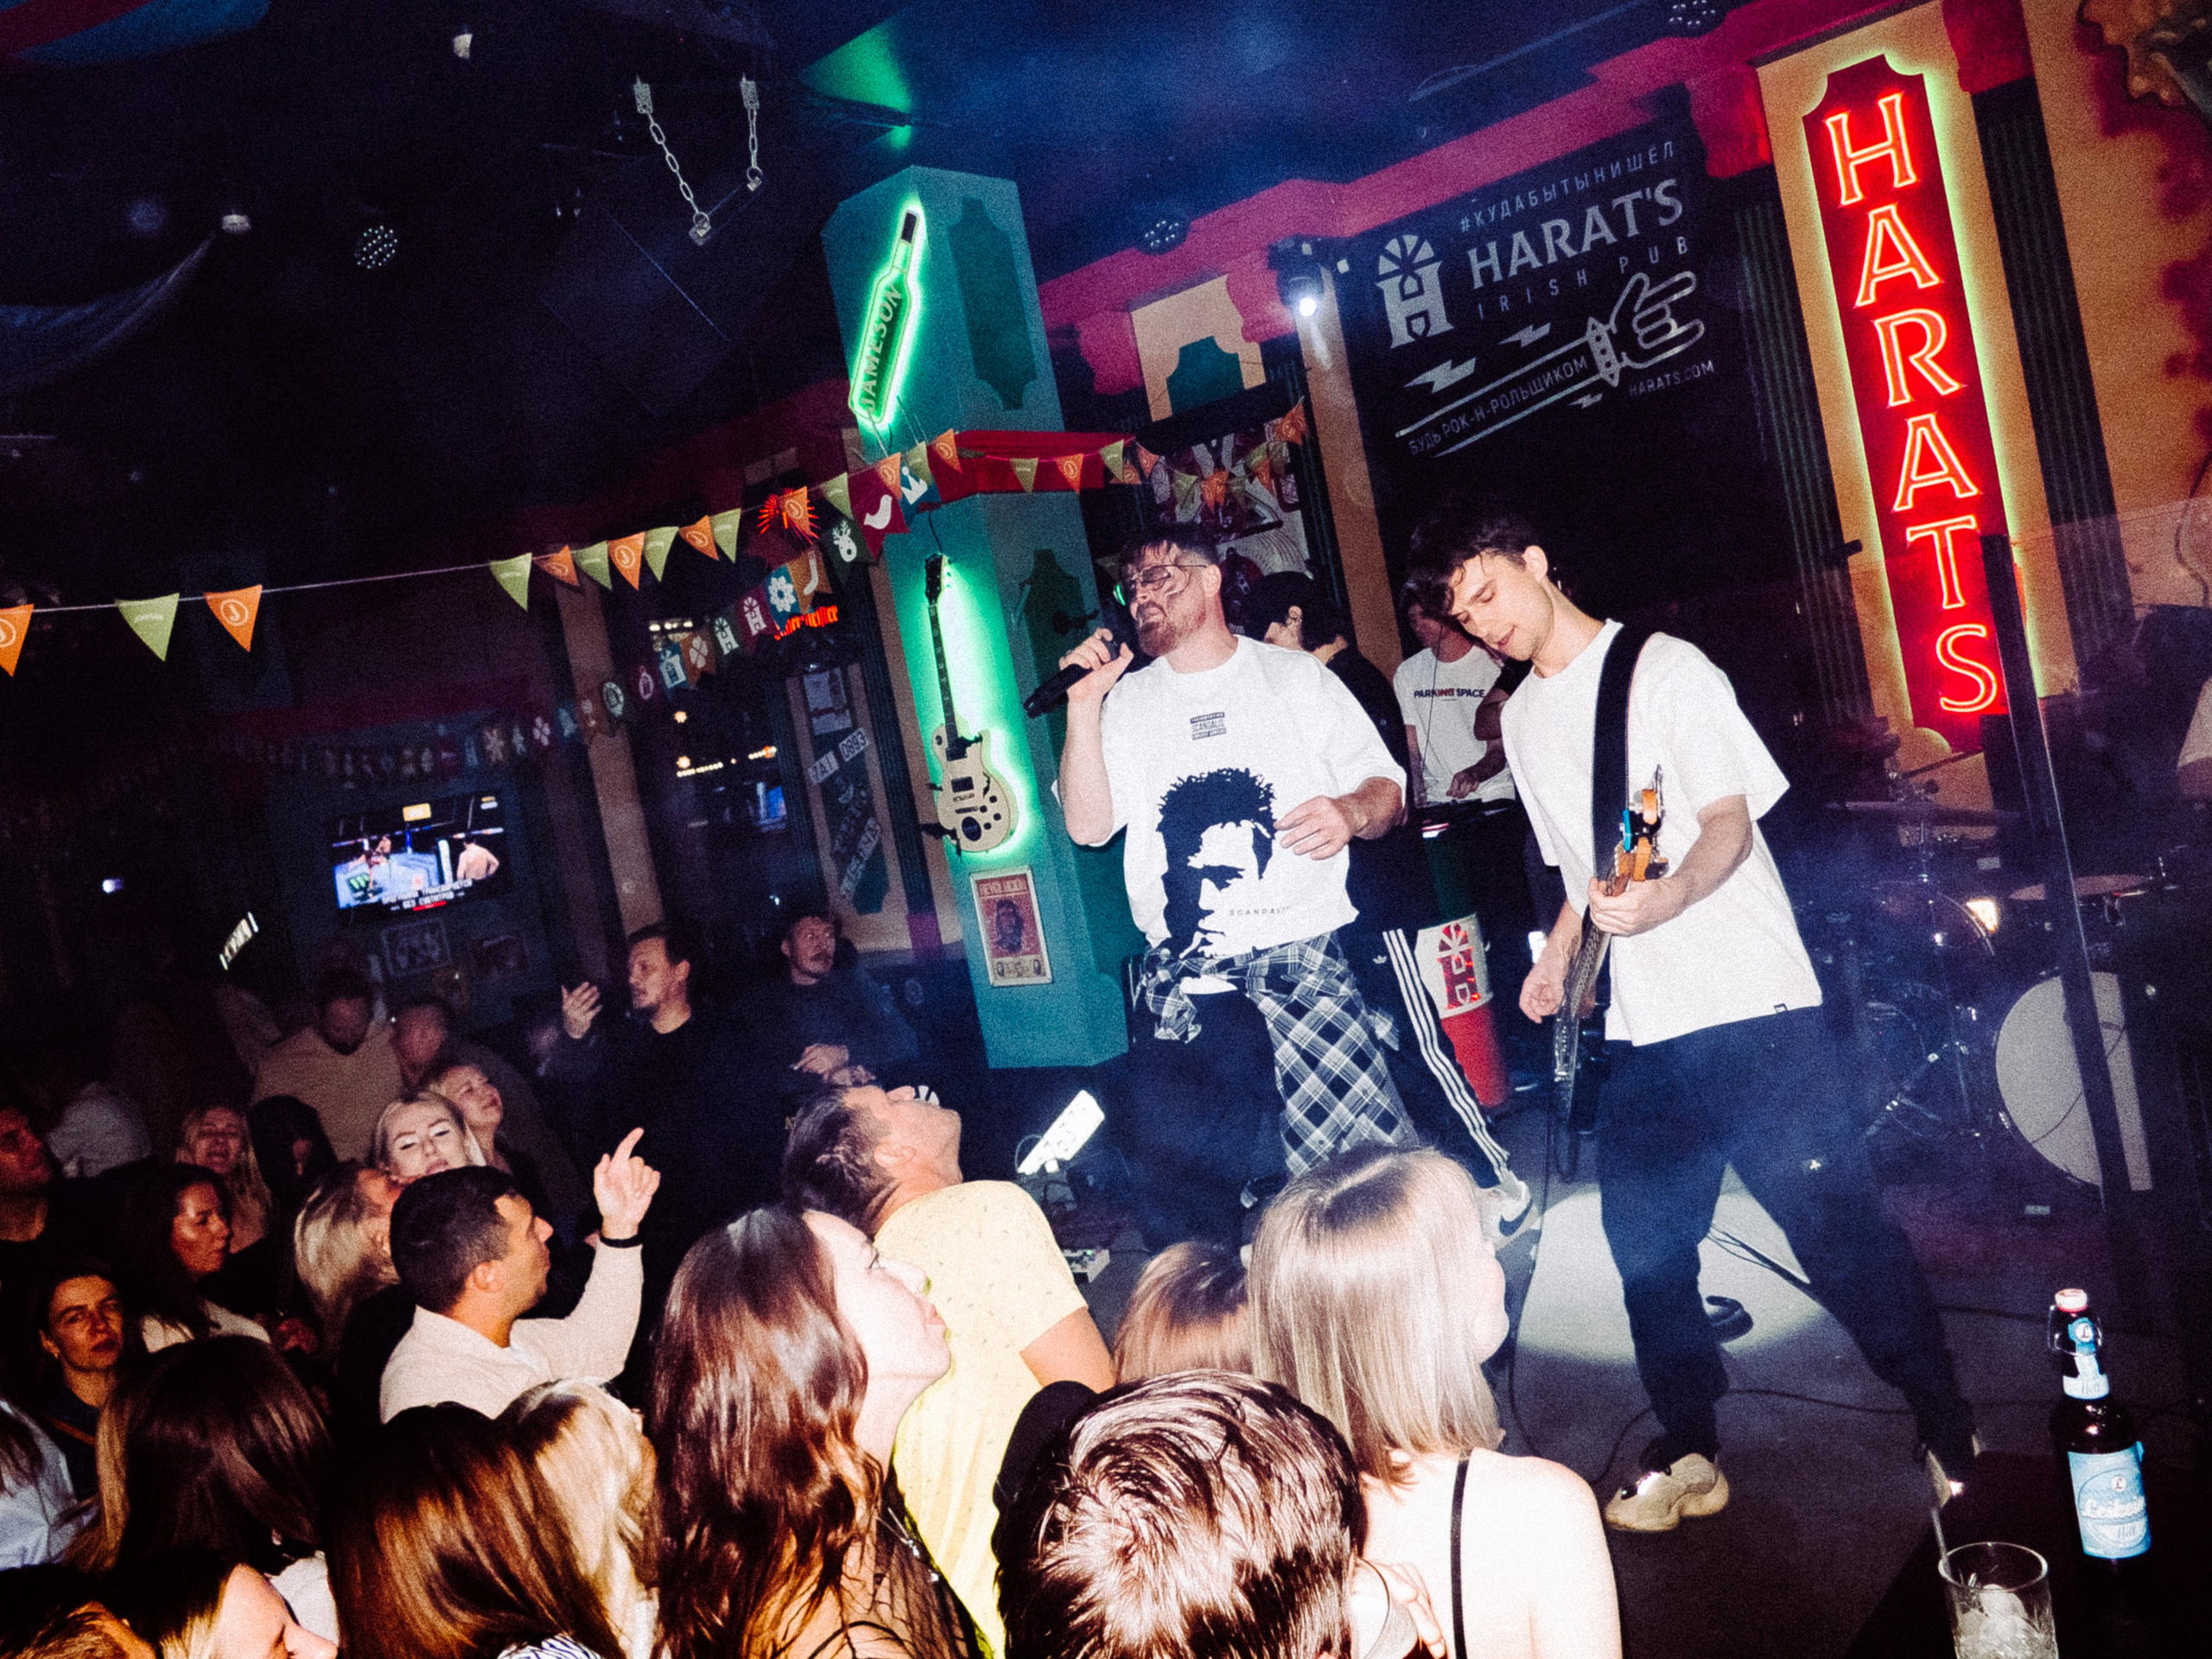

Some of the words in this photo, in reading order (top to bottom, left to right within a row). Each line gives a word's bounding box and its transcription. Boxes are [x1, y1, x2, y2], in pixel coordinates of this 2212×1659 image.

[1468, 179, 1683, 290] HARAT'S
[1478, 269, 1588, 320] IRISH
[1618, 236, 1688, 274] PUB
[860, 284, 902, 413] JAMESON
[1629, 360, 1715, 398] HARATS.COM
[1408, 430, 1441, 455] БУДЬ
[1823, 91, 1999, 715] HARATS
[1456, 688, 1486, 698] SPACE
